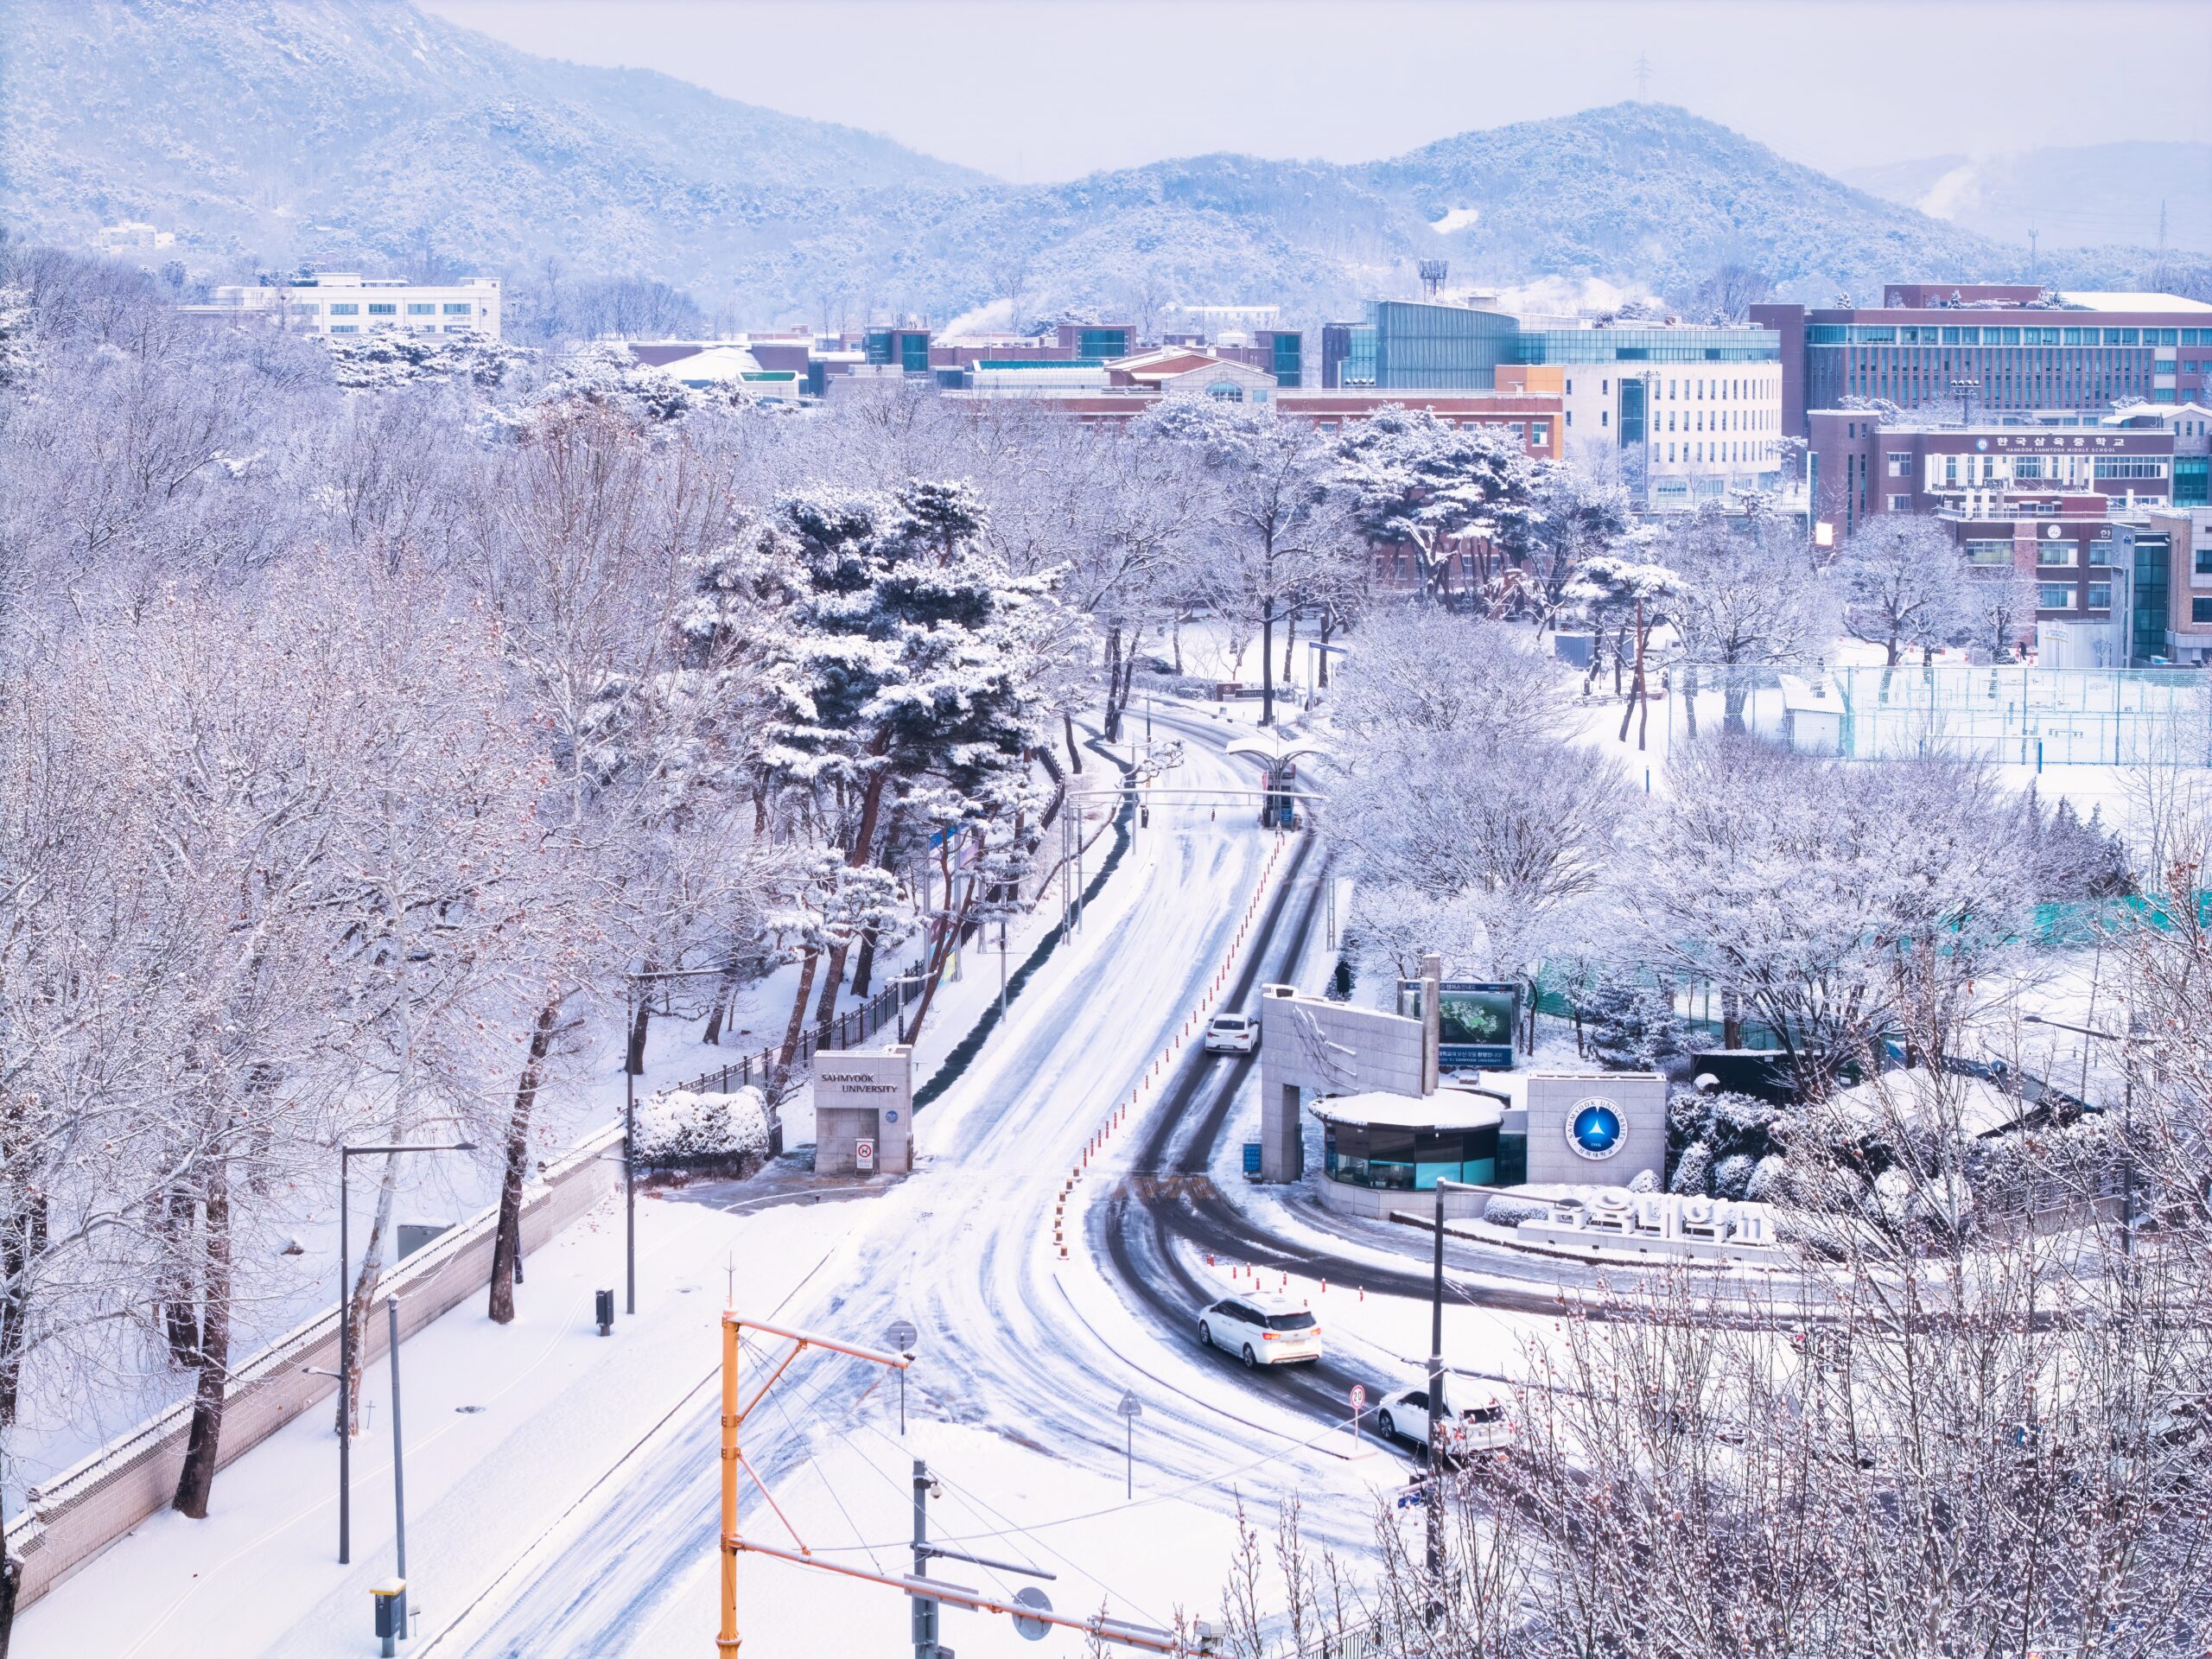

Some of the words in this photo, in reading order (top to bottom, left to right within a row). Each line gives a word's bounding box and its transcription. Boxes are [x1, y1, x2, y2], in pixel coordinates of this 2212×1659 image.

[1996, 436, 2125, 447] 한국삼육중학교
[822, 1074, 874, 1083] SAHMYOOK
[842, 1084, 898, 1093] UNIVERSITY
[1567, 1100, 1596, 1139] SAHMYOOK
[1600, 1100, 1626, 1141] UNIVERSITY
[1354, 1391, 1363, 1401] 20
